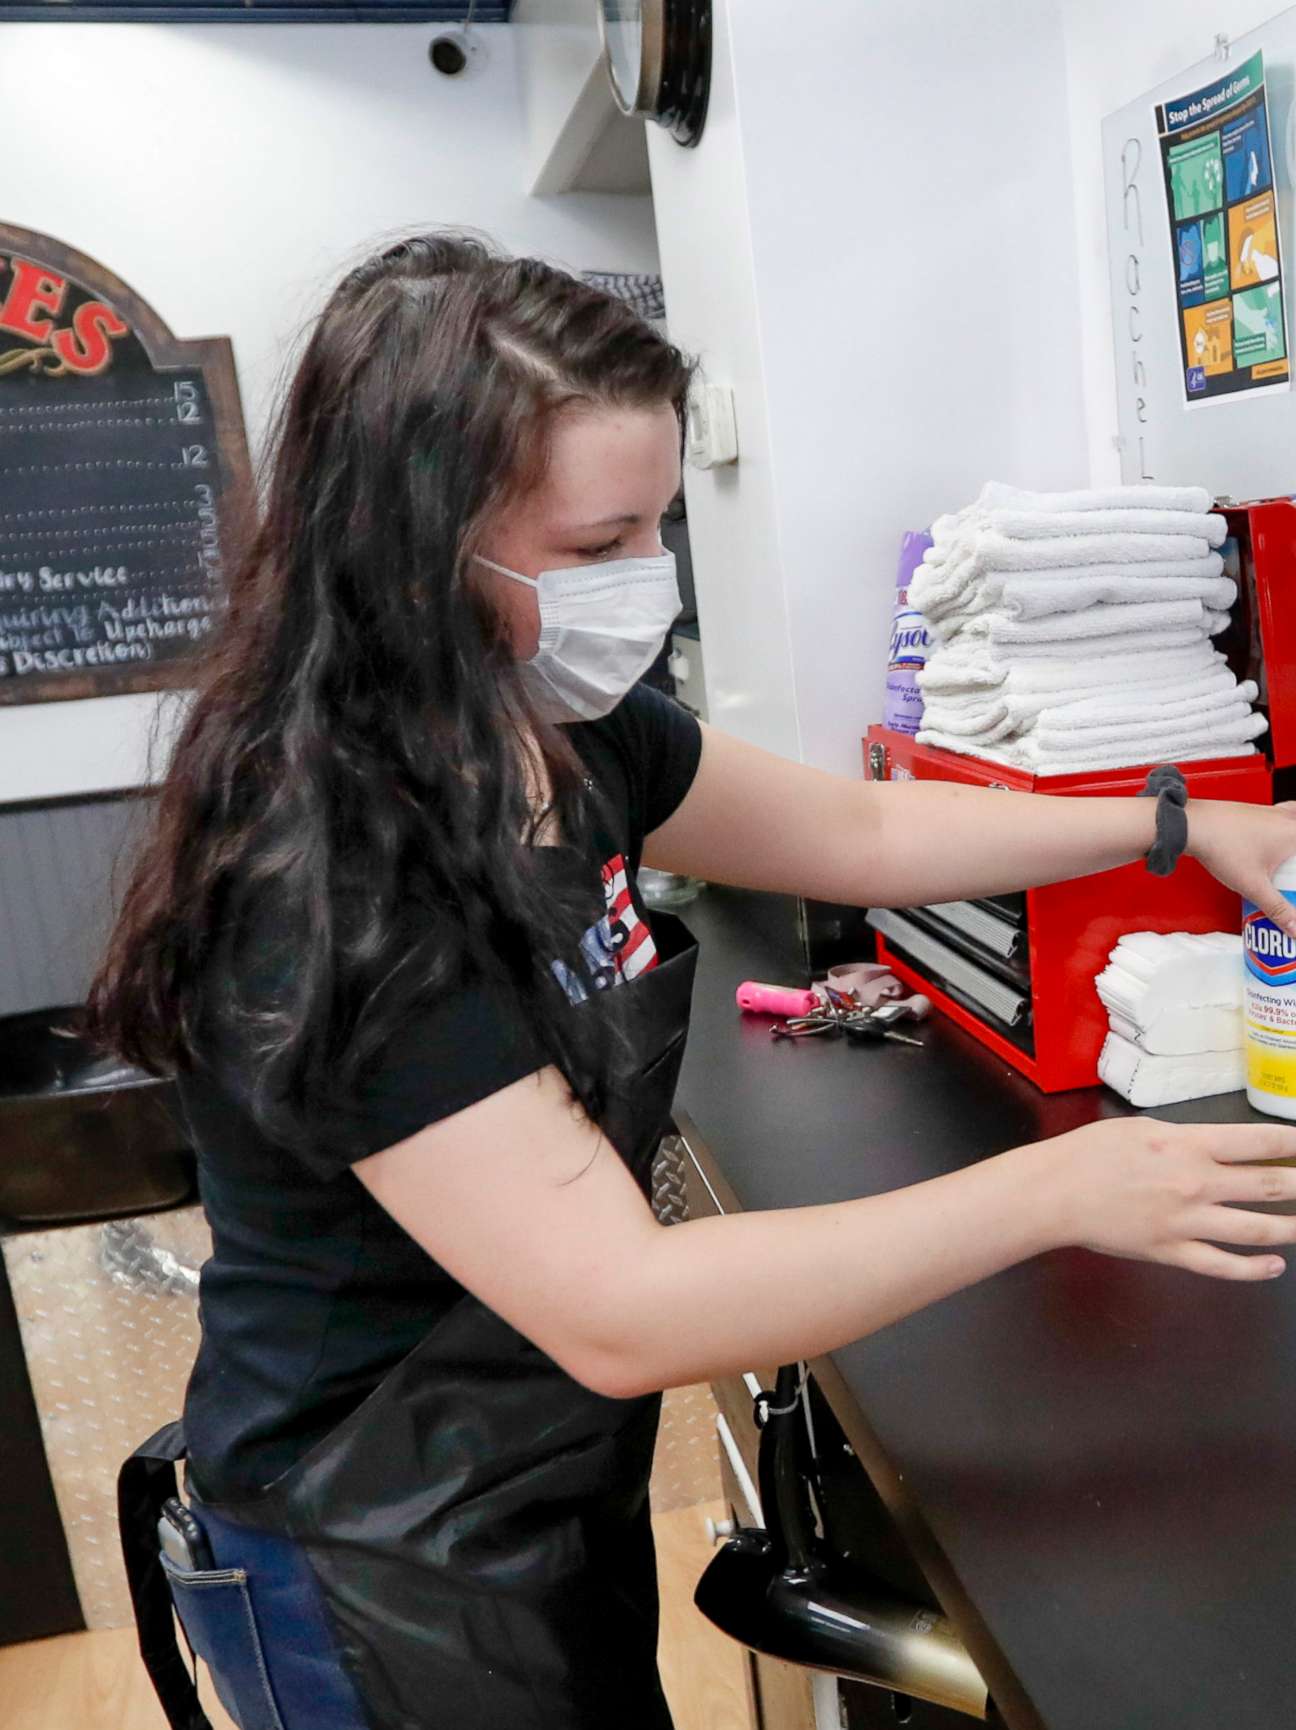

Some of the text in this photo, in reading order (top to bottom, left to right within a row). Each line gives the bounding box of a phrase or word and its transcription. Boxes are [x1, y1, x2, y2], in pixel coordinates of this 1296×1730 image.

[1167, 108, 1190, 124] Stop
[1189, 100, 1202, 117] the
[1202, 88, 1227, 112] Spread
[0, 256, 130, 375] ES
[173, 381, 198, 401] 15
[176, 402, 201, 424] 12
[181, 444, 207, 466] 12
[39, 566, 128, 593] Service
